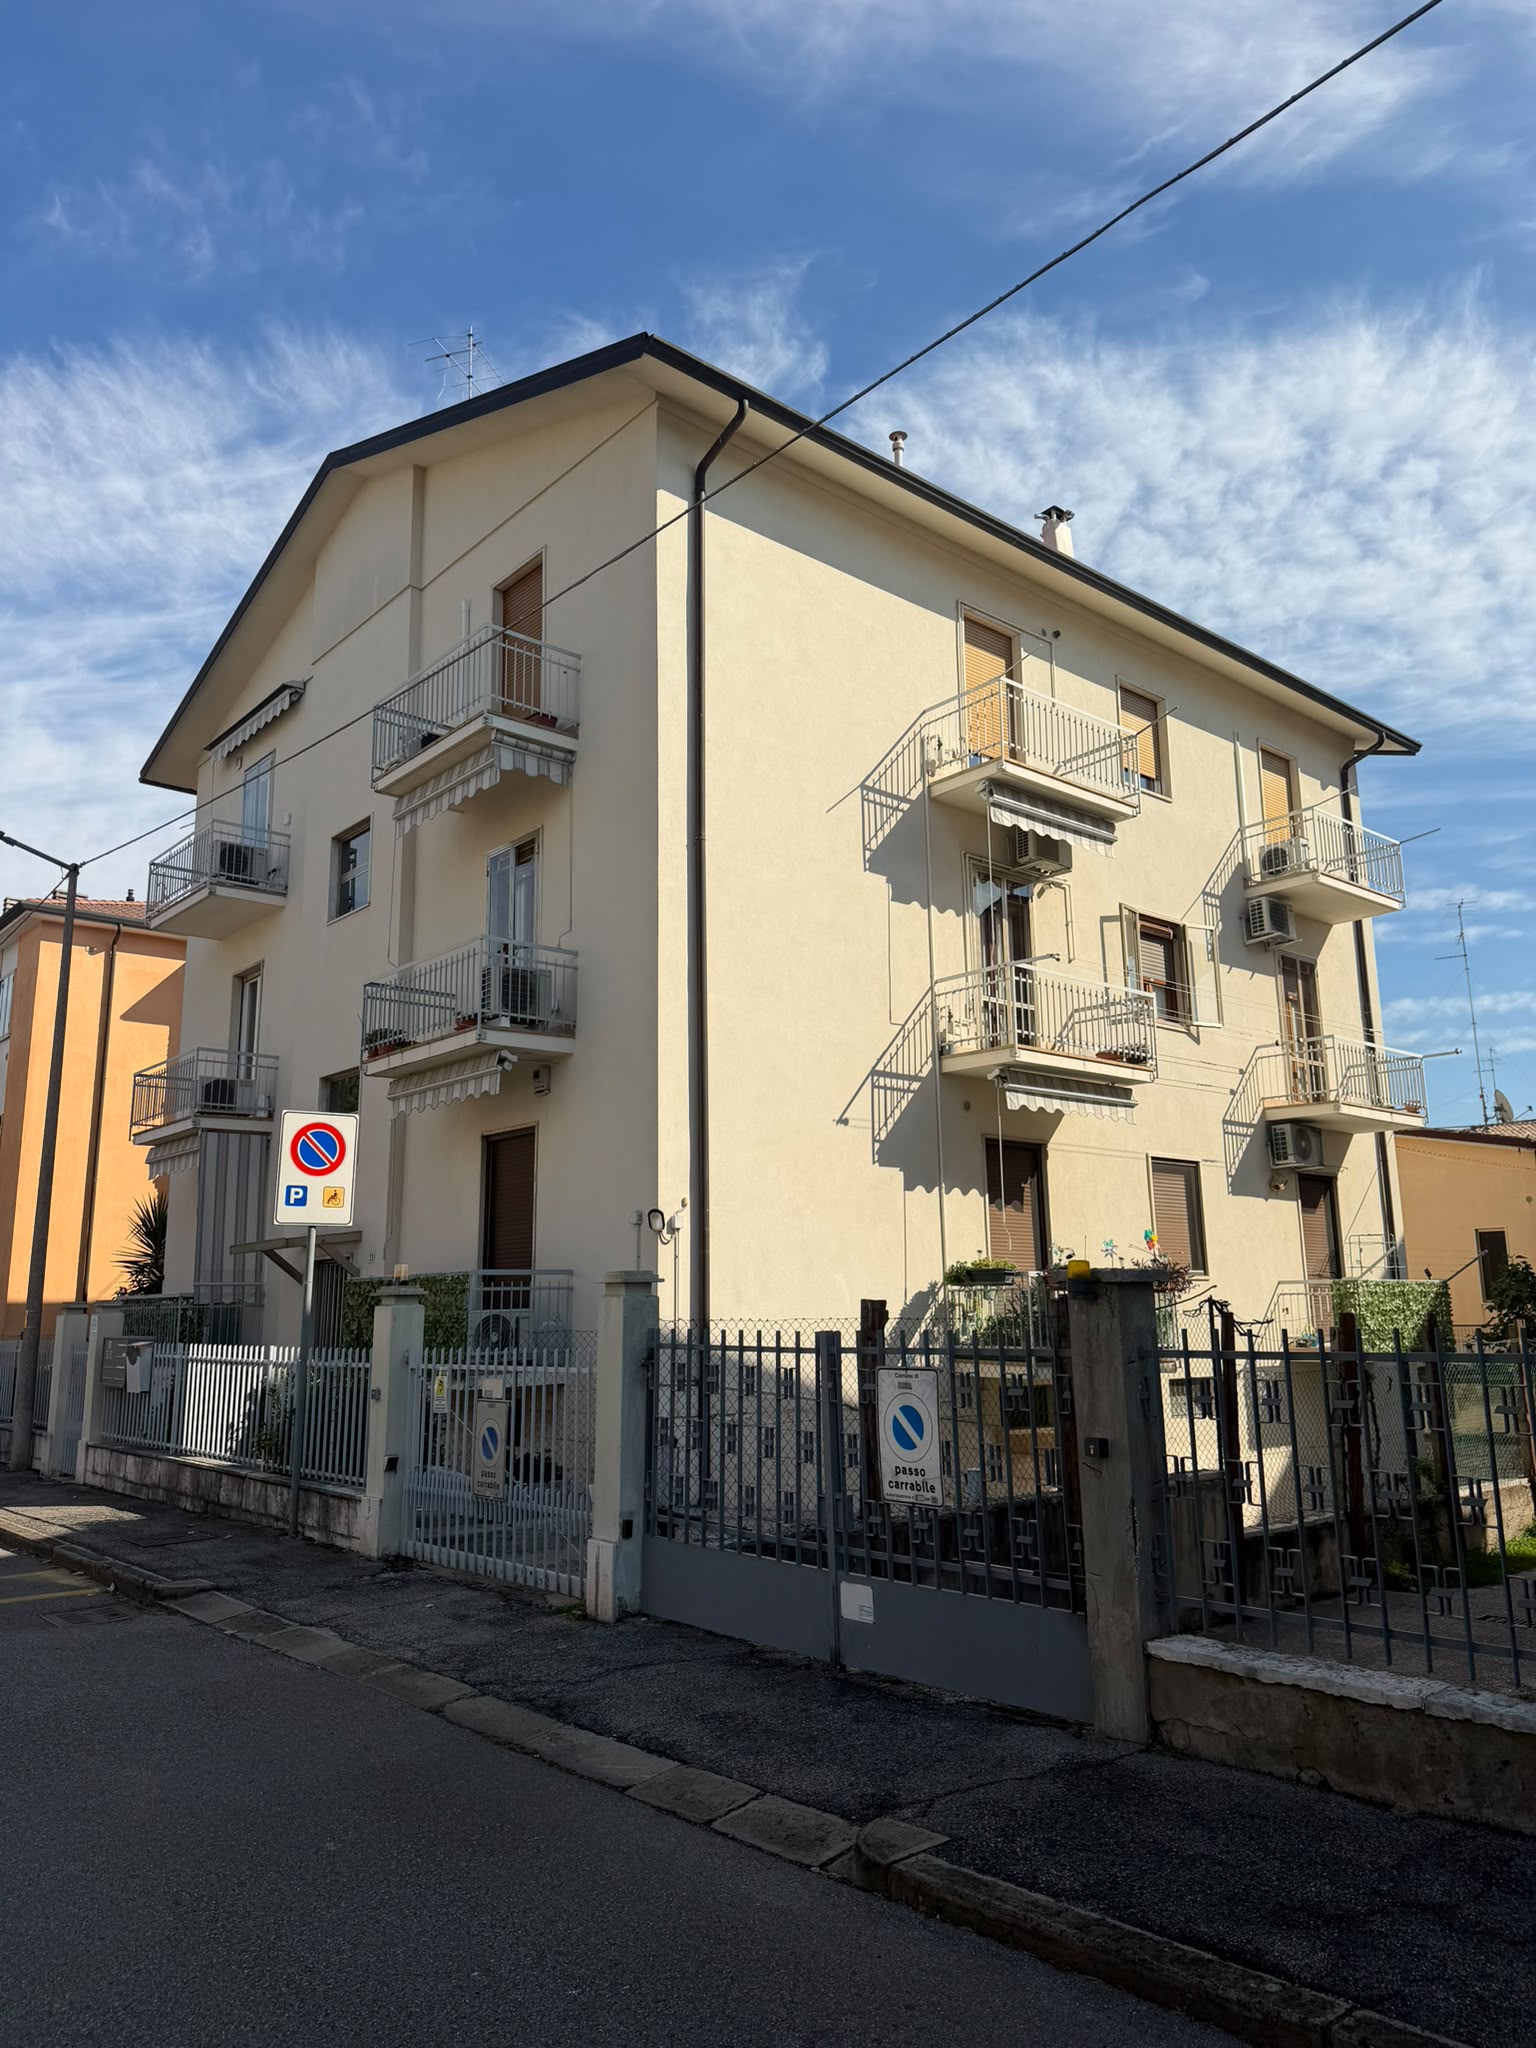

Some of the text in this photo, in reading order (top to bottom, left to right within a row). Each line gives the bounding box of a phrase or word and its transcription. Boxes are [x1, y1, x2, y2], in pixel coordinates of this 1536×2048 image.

[290, 1187, 304, 1205] P
[481, 1471, 496, 1479] passo
[895, 1466, 925, 1478] passo
[477, 1480, 500, 1489] carrabile
[888, 1479, 936, 1494] carrabile
